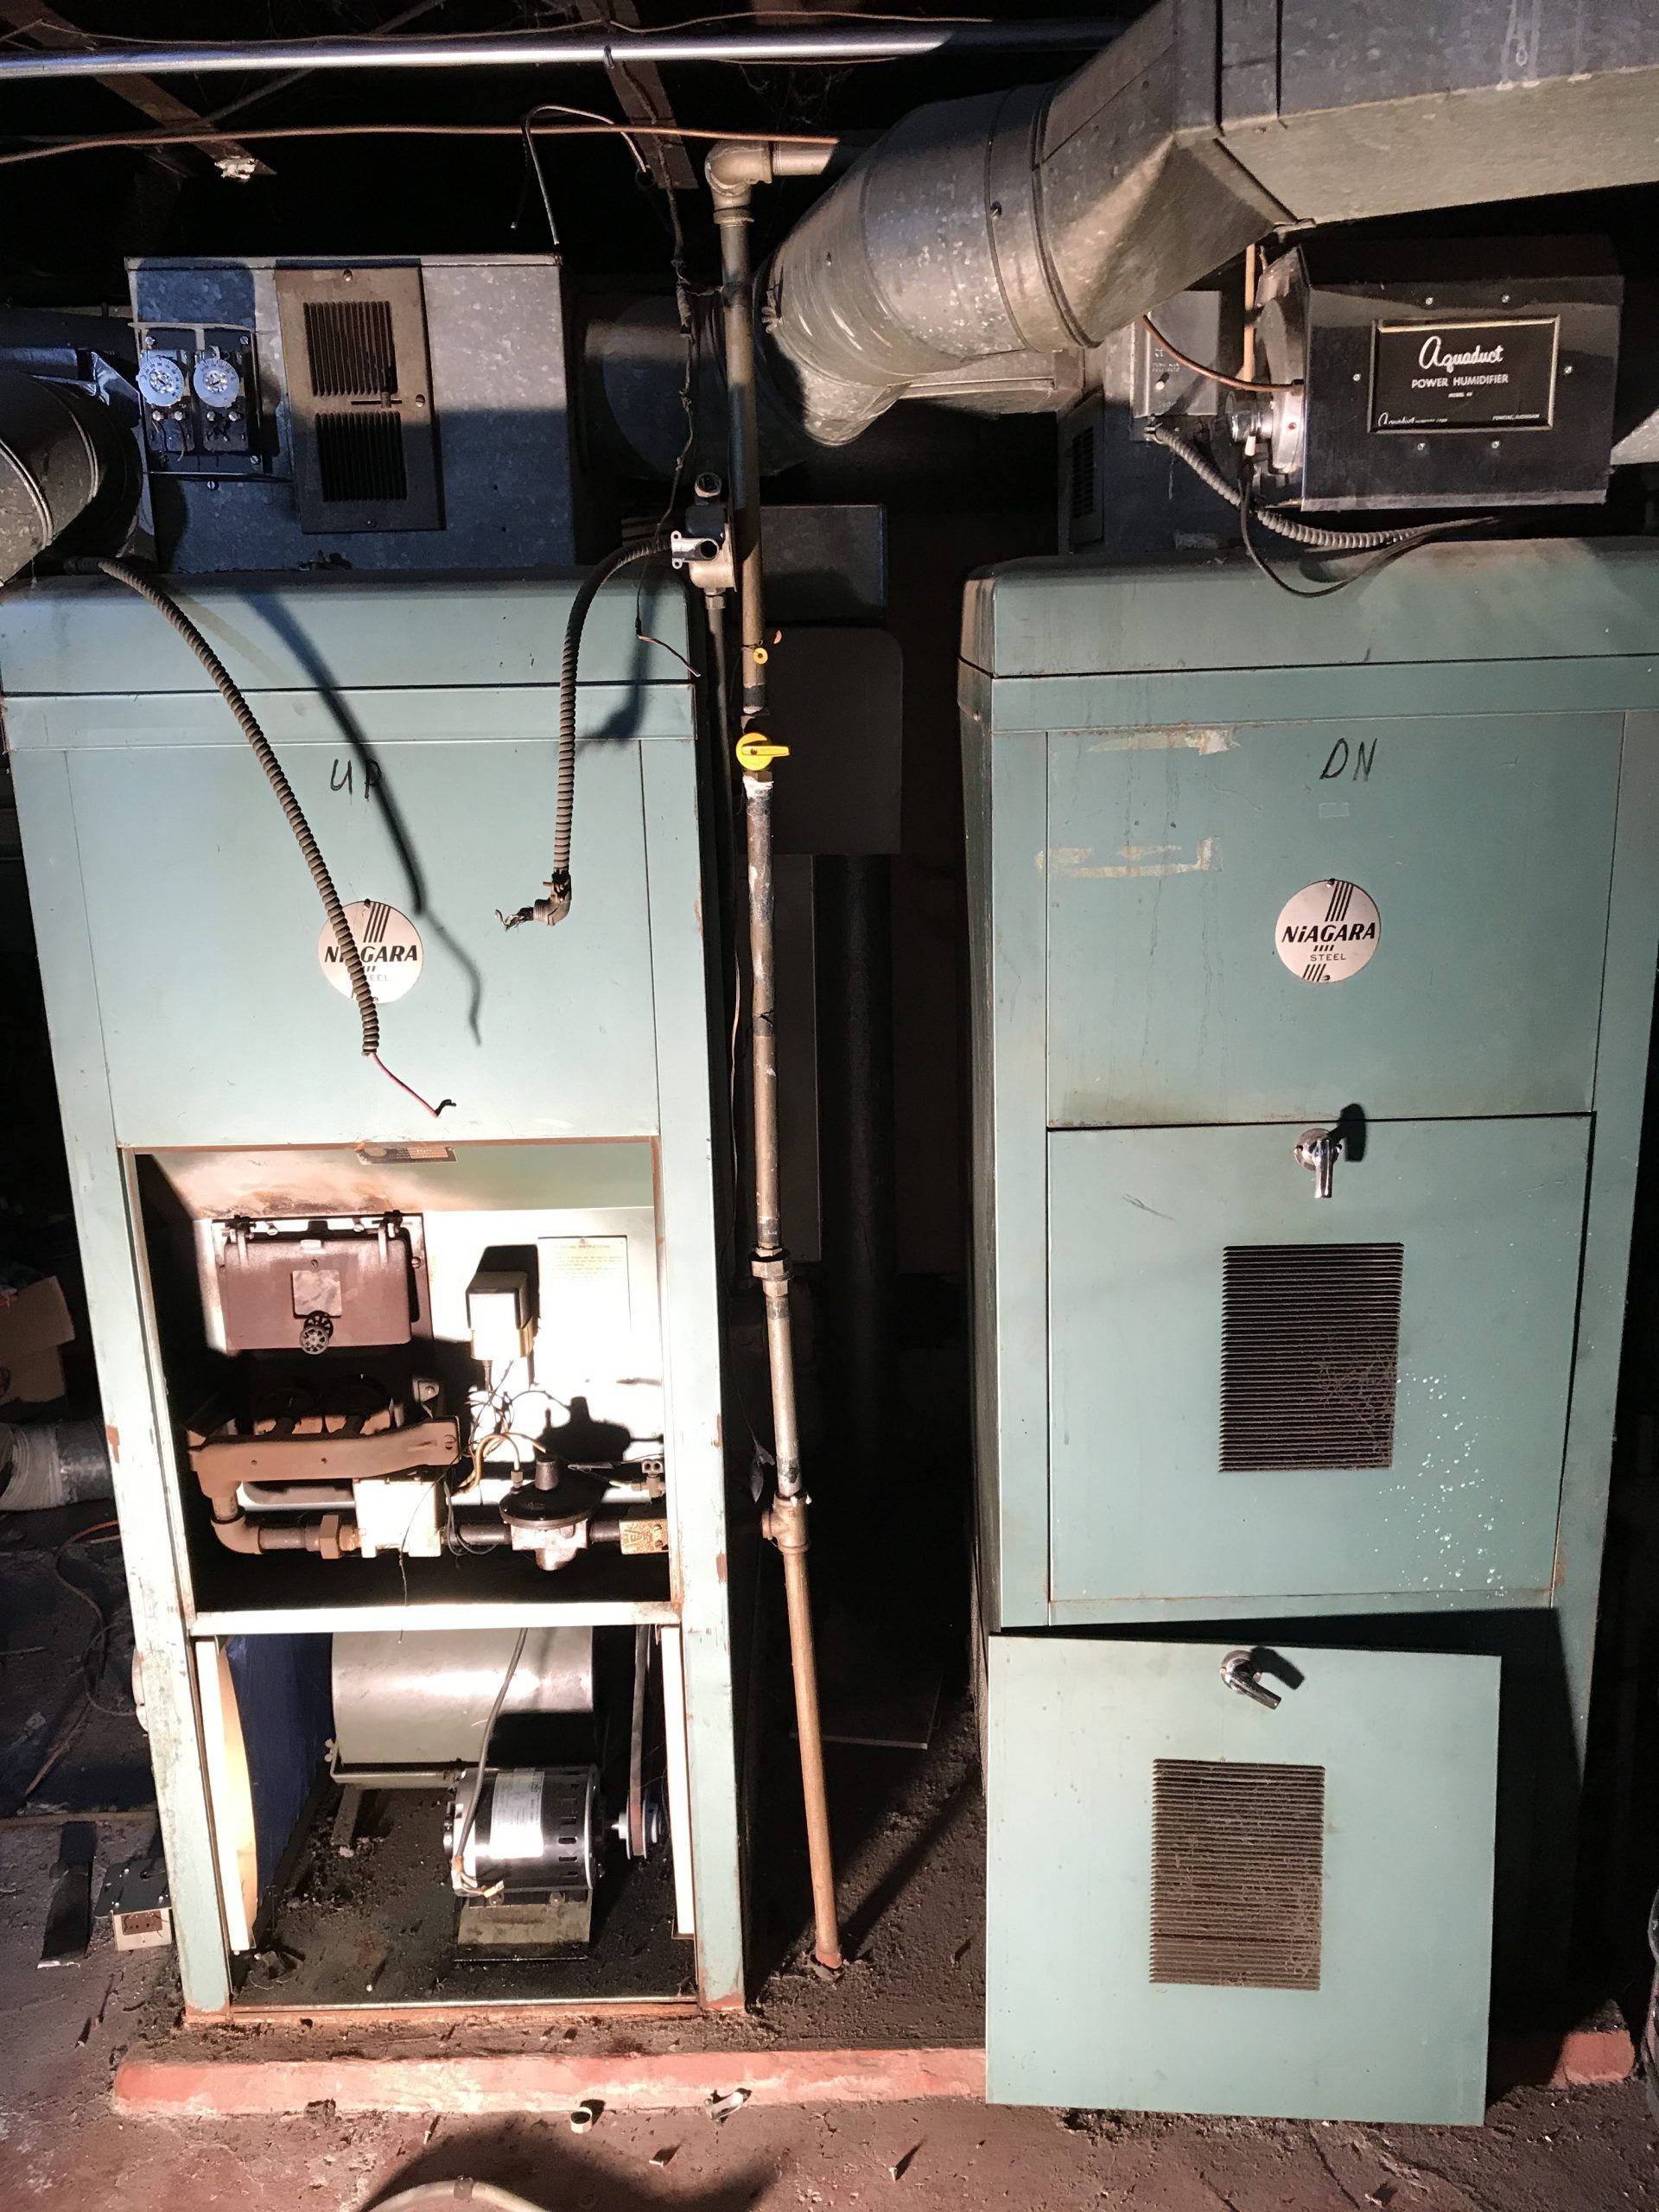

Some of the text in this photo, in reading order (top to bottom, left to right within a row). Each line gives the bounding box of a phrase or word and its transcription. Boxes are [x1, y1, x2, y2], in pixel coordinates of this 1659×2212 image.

[1418, 335, 1504, 373] Aquaduct
[1411, 373, 1510, 389] POWER HUMIDIFIER
[1319, 736, 1378, 782] DN
[330, 758, 383, 802] UP
[324, 944, 418, 963] NGARA
[1310, 953, 1347, 963] STEEL
